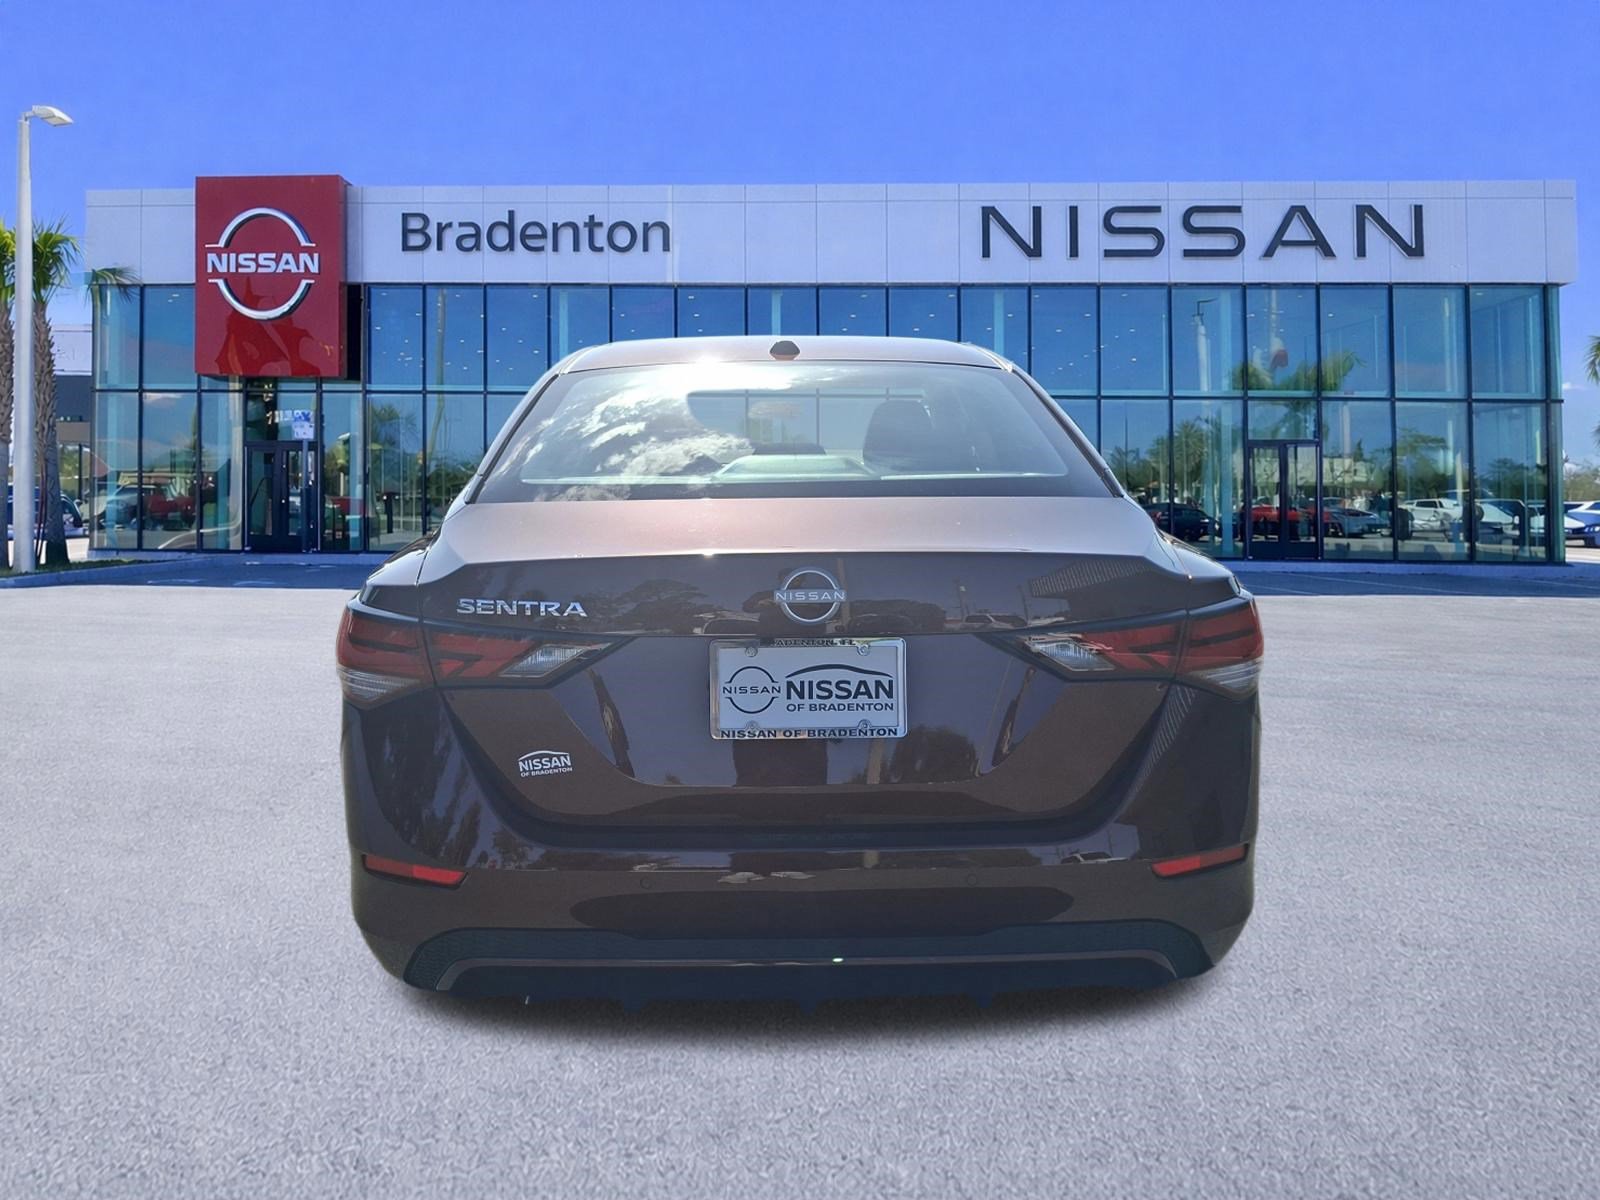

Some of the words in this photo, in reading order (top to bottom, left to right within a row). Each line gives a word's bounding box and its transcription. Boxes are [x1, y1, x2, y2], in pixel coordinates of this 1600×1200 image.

[400, 210, 672, 253] Bradenton
[981, 205, 1425, 258] NISSAN
[206, 252, 320, 275] NISSAN
[775, 591, 845, 601] NISSAN
[456, 598, 588, 618] SENTRA
[722, 685, 781, 695] NISSAN
[786, 679, 894, 700] NISSAN
[786, 702, 806, 713] OF
[809, 702, 894, 712] BRADENTON
[720, 729, 777, 739] NISSAN
[783, 729, 801, 738] OF
[807, 728, 898, 738] BRADENTON
[518, 755, 572, 771] NISSAN
[531, 767, 573, 776] BRADENTON
